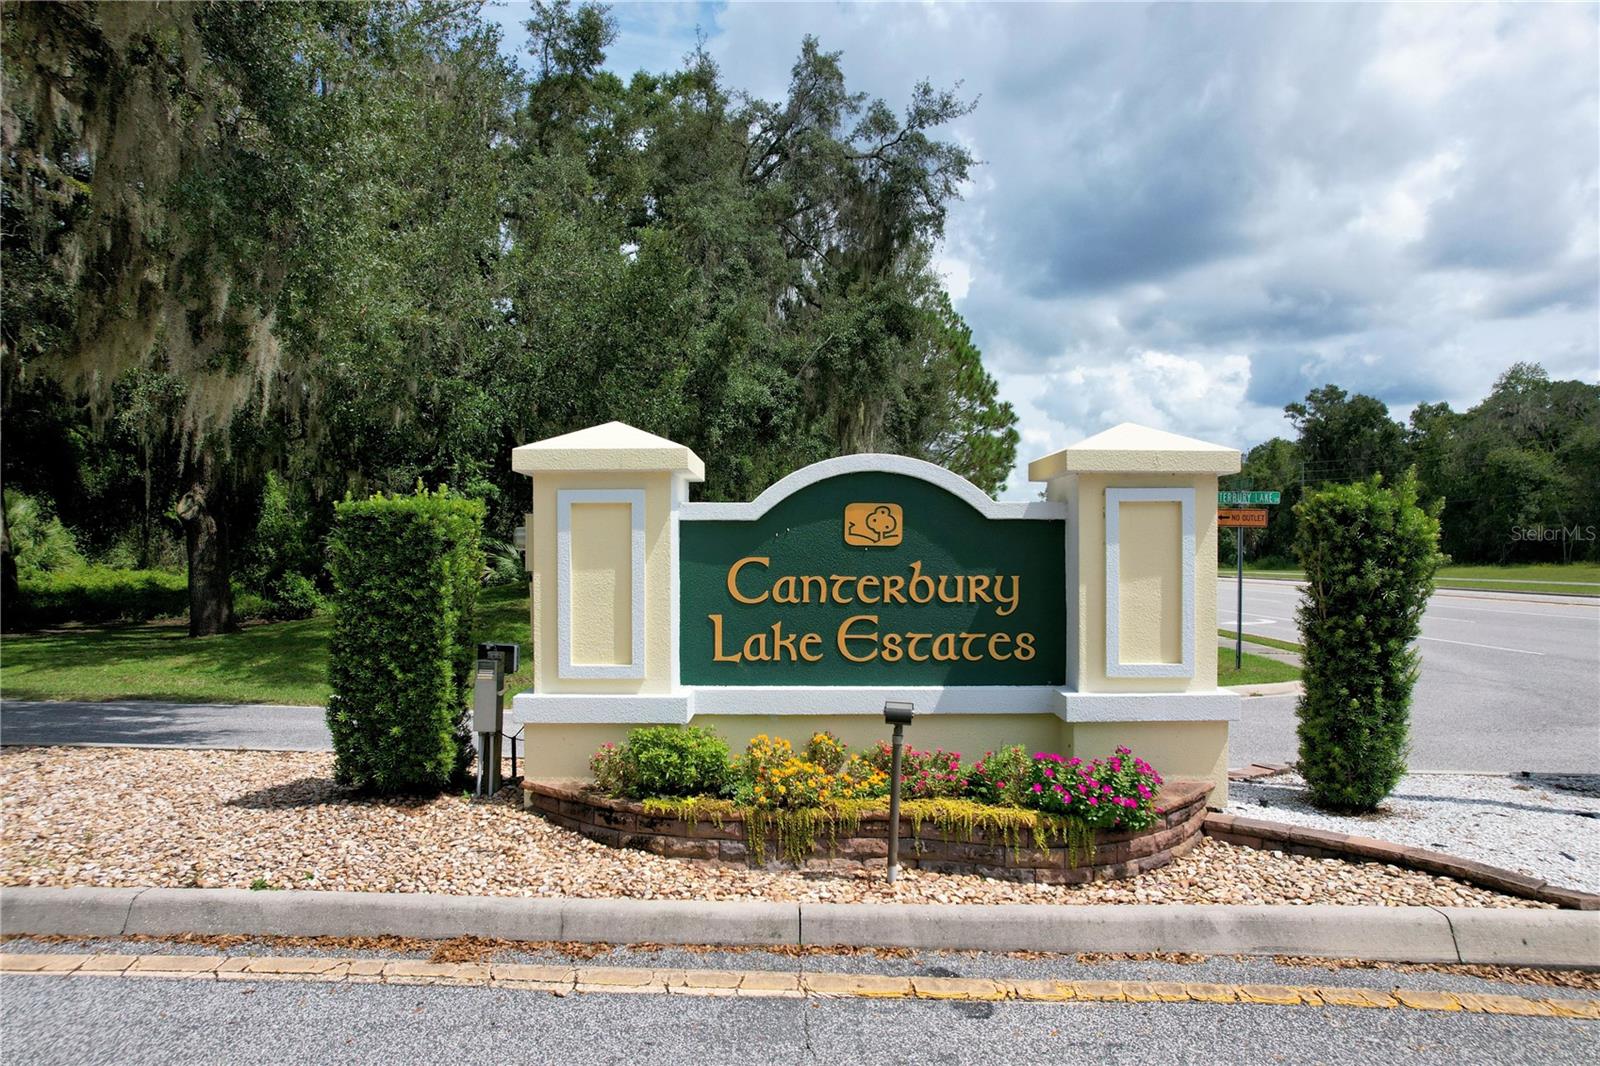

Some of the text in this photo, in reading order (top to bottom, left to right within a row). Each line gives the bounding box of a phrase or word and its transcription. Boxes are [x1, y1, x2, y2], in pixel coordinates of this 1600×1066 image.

[1255, 491, 1273, 503] LAKE
[1231, 514, 1265, 522] NO OUTLET
[727, 556, 1021, 616] Canterbury
[708, 614, 1036, 663] Lake Estates
